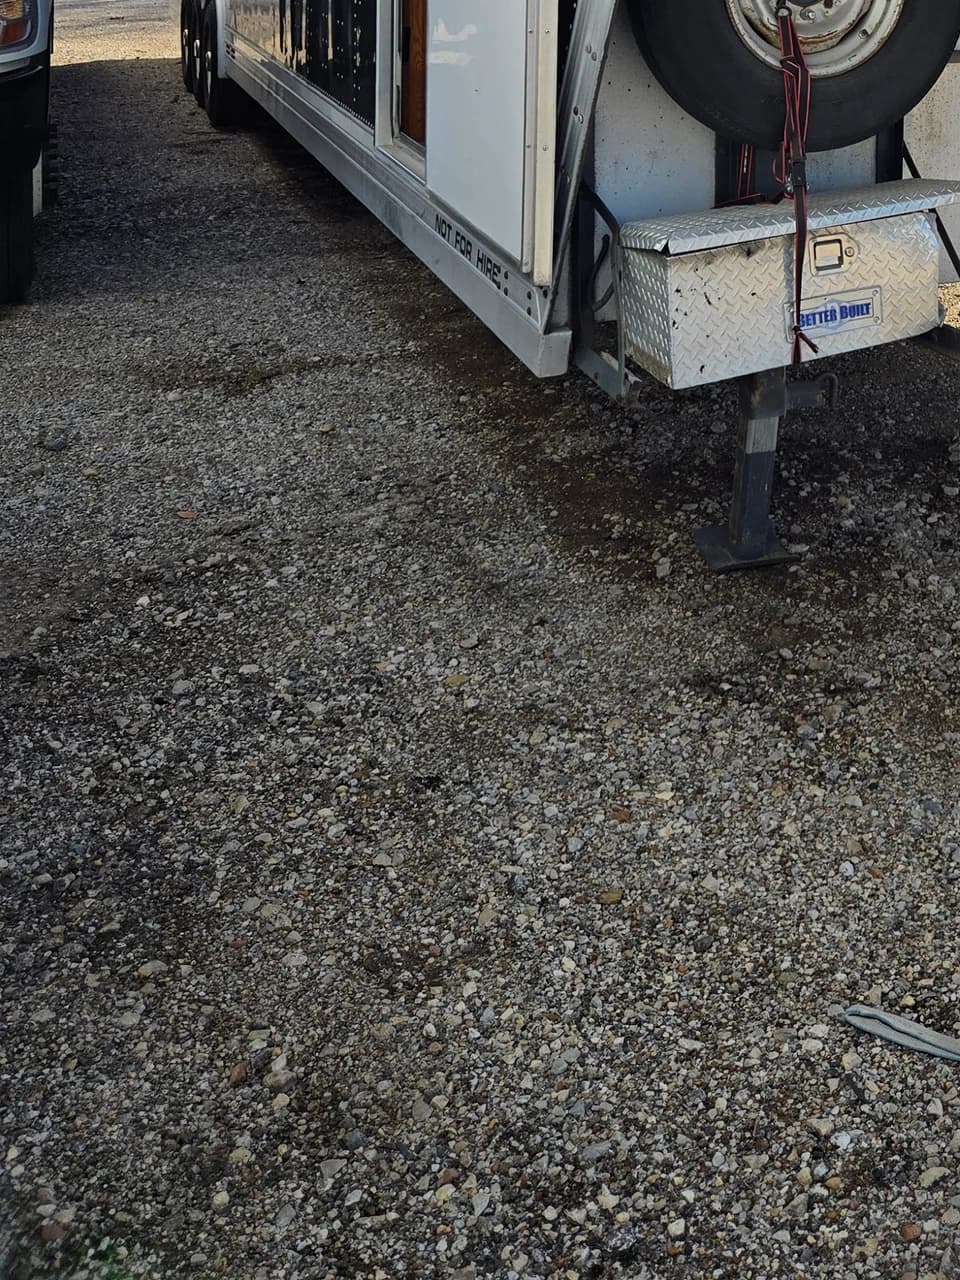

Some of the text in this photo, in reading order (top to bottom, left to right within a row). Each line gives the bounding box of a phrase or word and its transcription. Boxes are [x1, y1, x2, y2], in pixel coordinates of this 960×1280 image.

[435, 214, 502, 290] NOT FOR HIRE
[840, 303, 871, 319] BUILT
